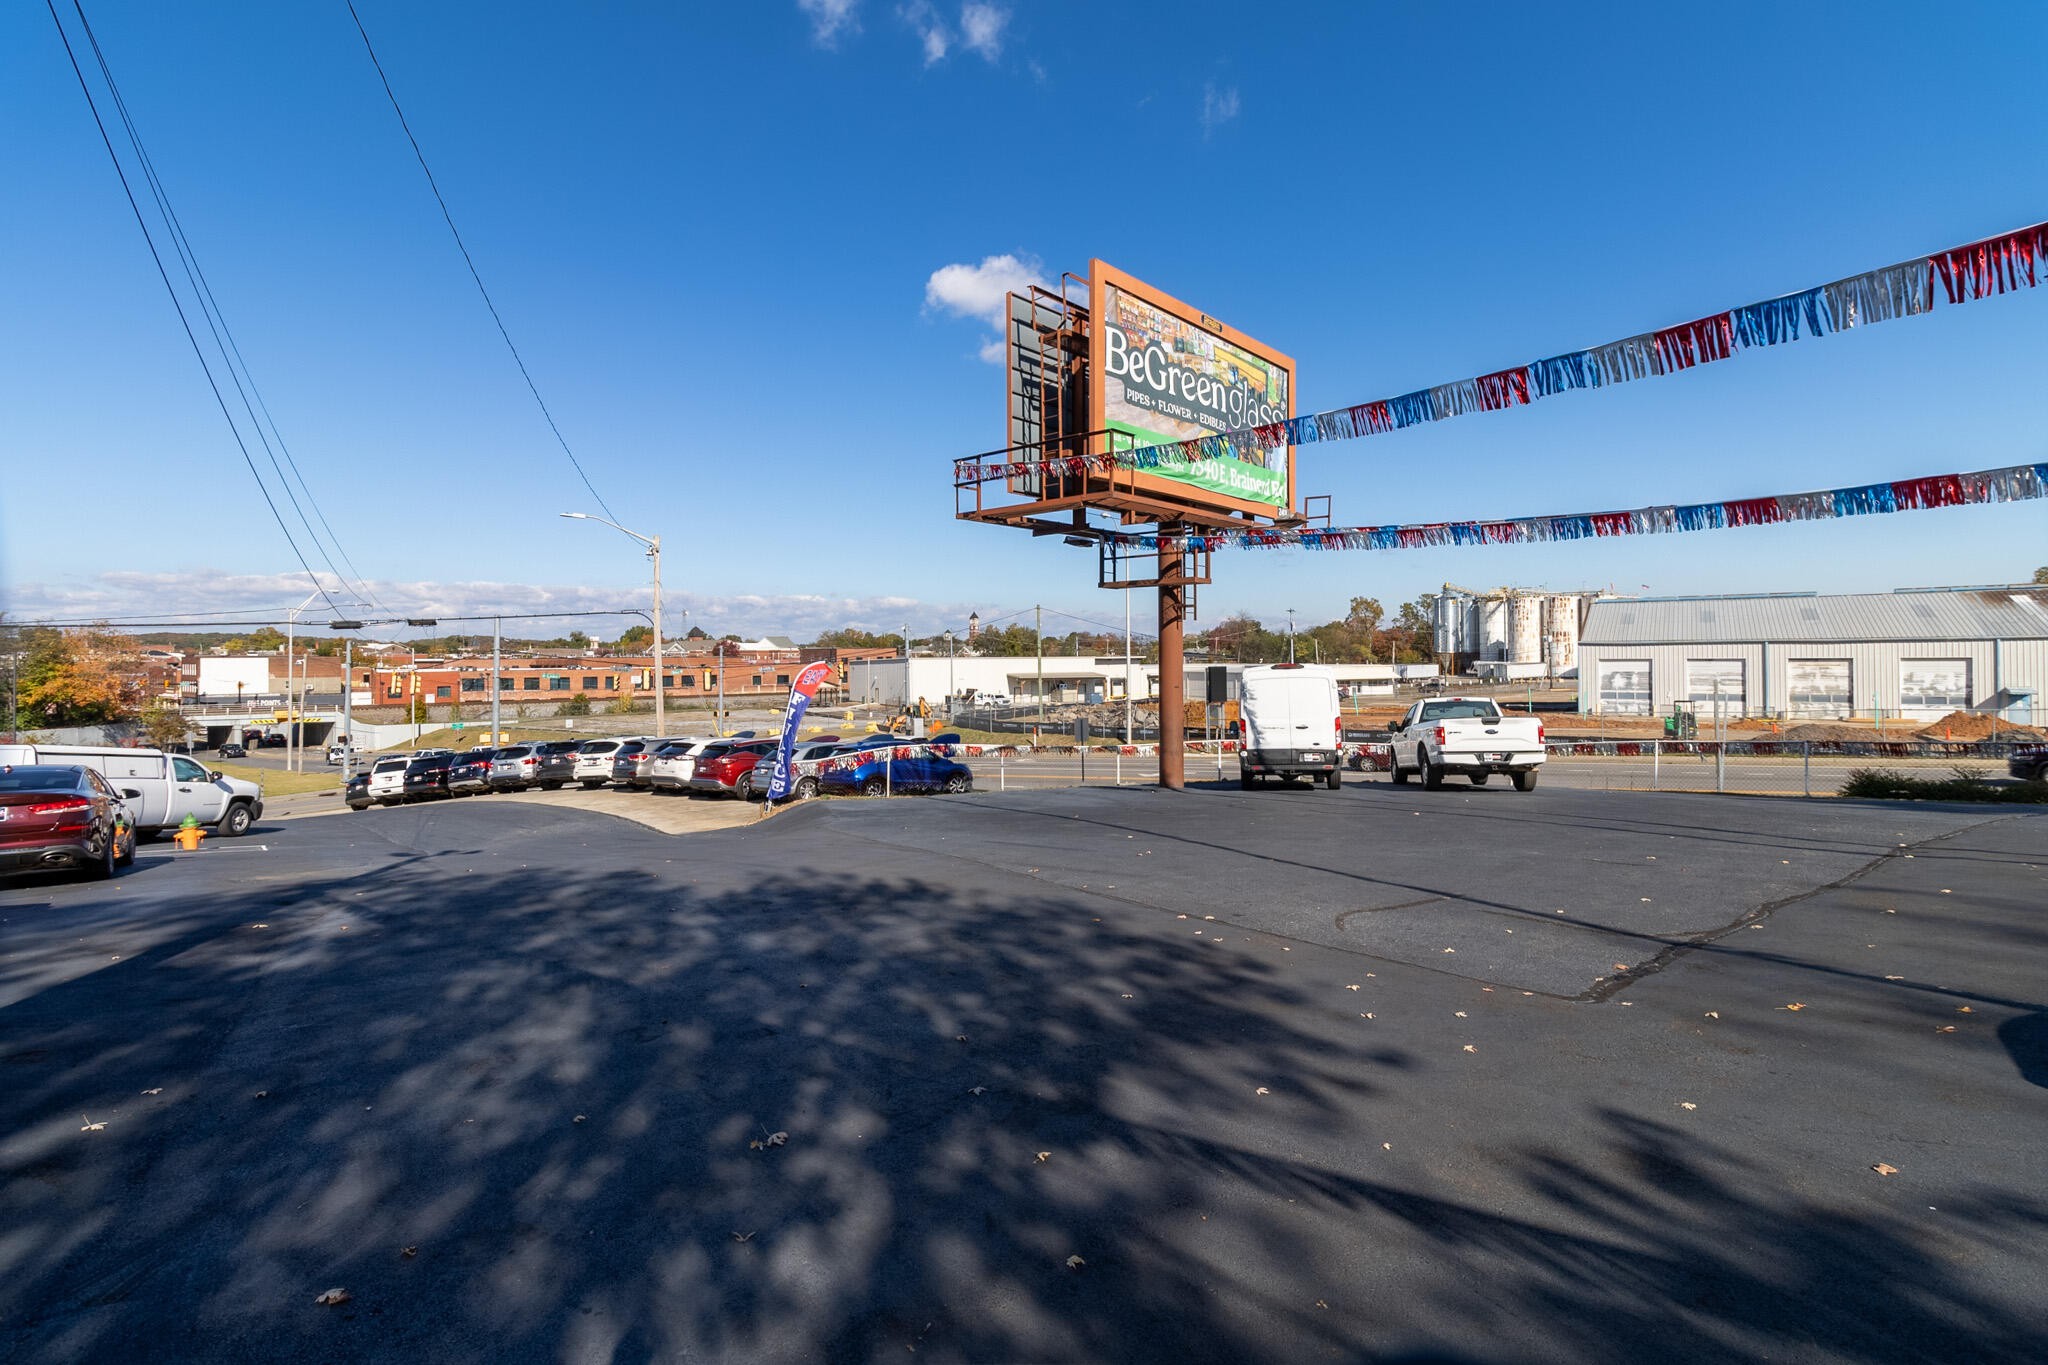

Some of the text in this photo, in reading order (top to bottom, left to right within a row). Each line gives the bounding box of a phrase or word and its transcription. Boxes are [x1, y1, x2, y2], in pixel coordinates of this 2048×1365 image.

[1105, 325, 1227, 413] BeGreen
[1127, 388, 1227, 431] PIPES FLOWER EDIBLES
[1230, 467, 1271, 496] Brainerd
